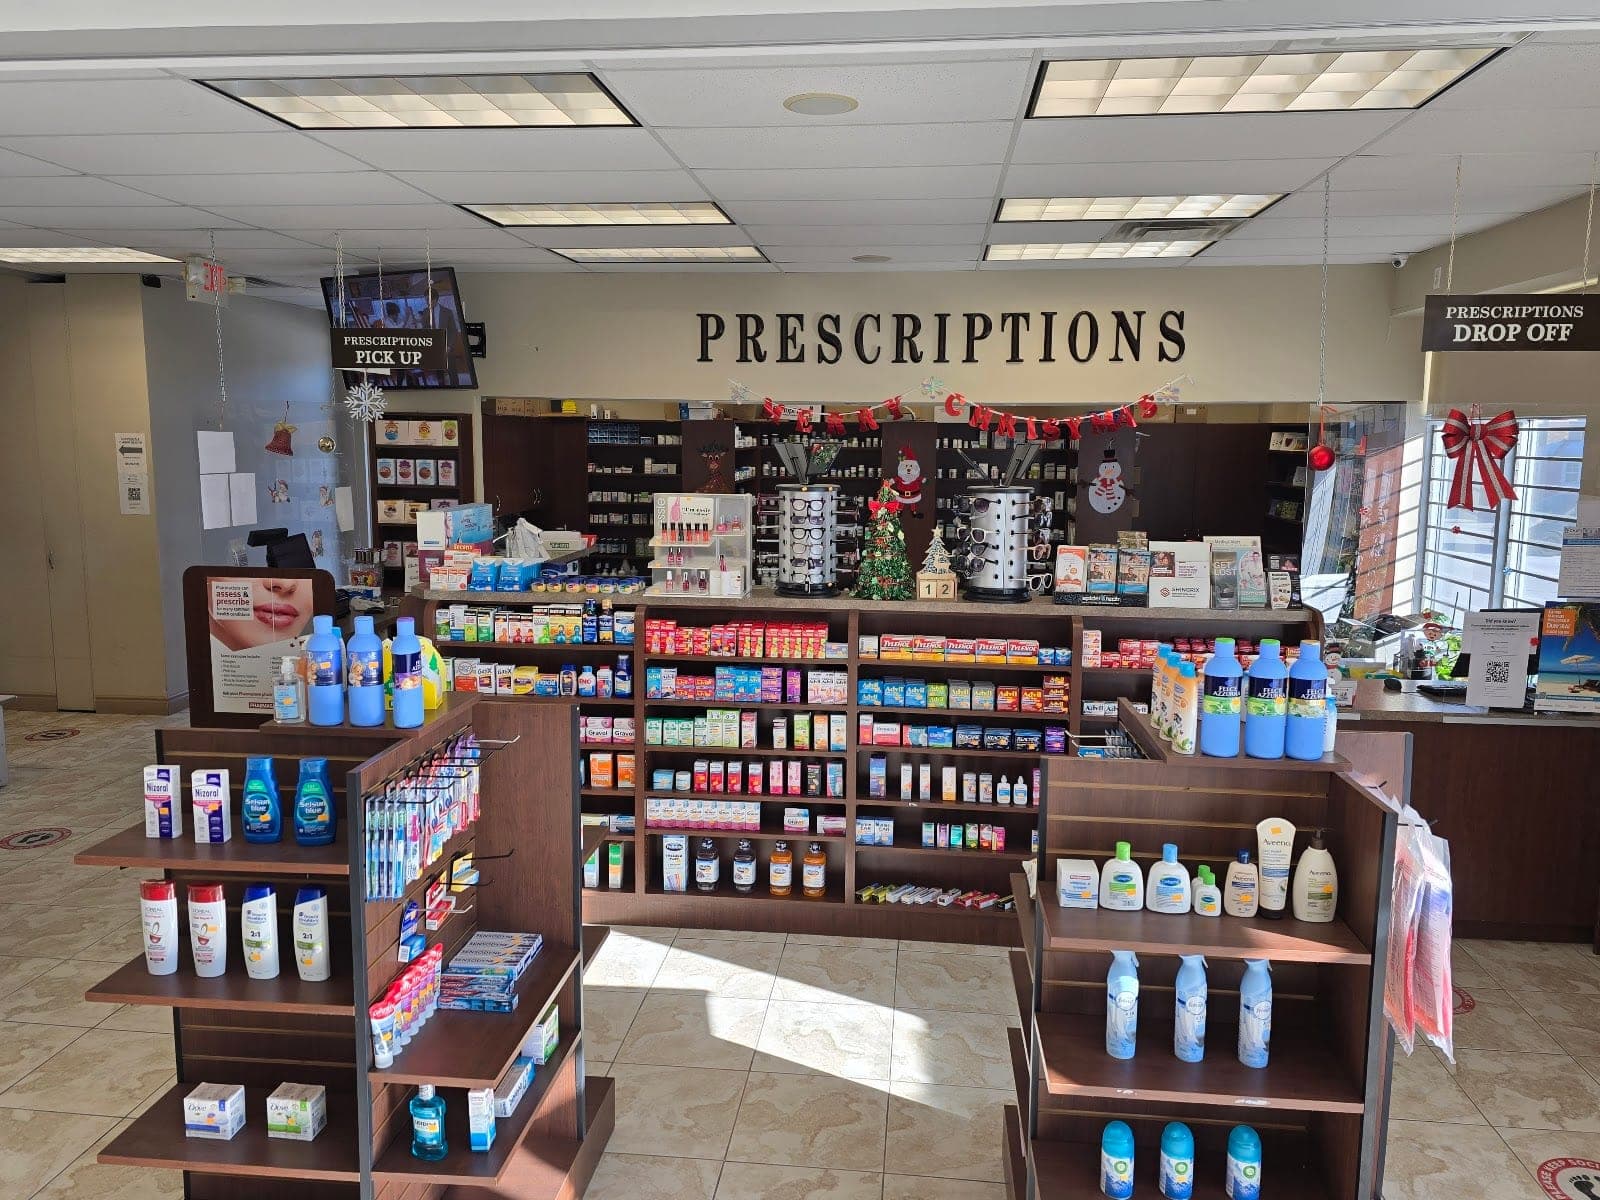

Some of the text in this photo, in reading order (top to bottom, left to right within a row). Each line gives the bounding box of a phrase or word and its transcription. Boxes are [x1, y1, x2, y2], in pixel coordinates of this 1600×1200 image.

[1445, 305, 1584, 319] PRESCRIPTIONS
[696, 310, 1187, 364] PRESCRIPTIONS
[1452, 323, 1574, 342] DROP OFF
[344, 336, 433, 347] PRESCRIPTIONS
[355, 350, 423, 365] PICK UP
[925, 583, 932, 595] 1
[942, 584, 950, 595] 2
[216, 597, 250, 606] prescribe
[883, 639, 910, 648] TYLENOL
[916, 640, 942, 649] TYLENOL
[947, 642, 974, 650] TYLENOL
[978, 642, 1005, 651] TYLENOL
[1010, 643, 1037, 652] TYLENOL
[885, 685, 904, 693] Advil
[906, 686, 925, 694] Advil
[999, 690, 1018, 698] Advil
[1022, 690, 1042, 698] Advil
[1085, 703, 1104, 711] Advil
[146, 782, 169, 793] Nizoral
[194, 787, 219, 798] Nizoral
[245, 798, 270, 807] Selsun
[298, 800, 326, 808] Selsun
[250, 804, 267, 812] blue
[304, 806, 322, 814] blue
[1262, 838, 1291, 848] Aveeno
[1310, 869, 1332, 877] Aveeno
[1233, 874, 1255, 882] Aveeno
[188, 1103, 207, 1112] Dove
[270, 1103, 289, 1112] Dove
